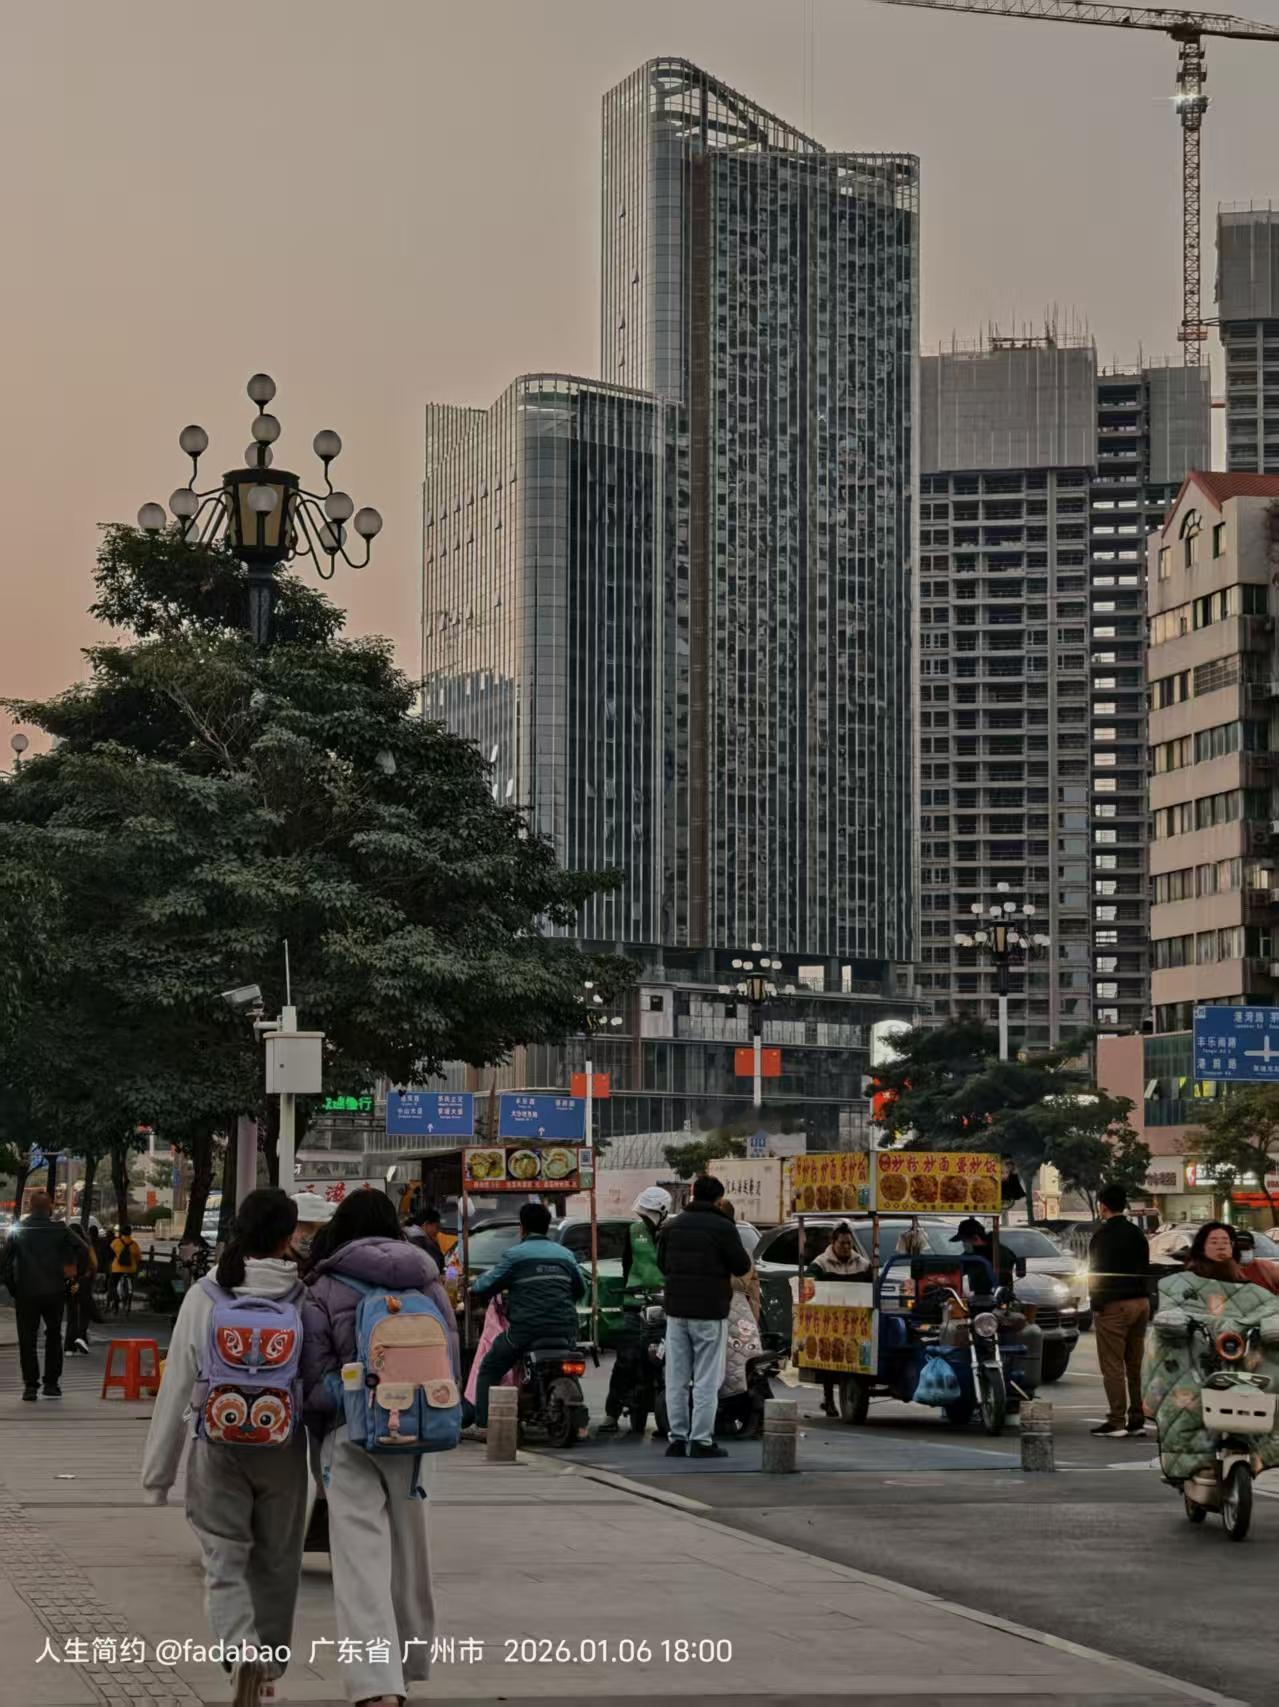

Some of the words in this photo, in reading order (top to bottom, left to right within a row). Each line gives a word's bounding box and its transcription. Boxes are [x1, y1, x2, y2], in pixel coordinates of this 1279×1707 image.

[1196, 1036, 1237, 1049] 丰乐南路
[892, 1153, 919, 1173] 炒粉
[923, 1153, 950, 1173] 炒面
[956, 1154, 998, 1174] 蛋炒饭
